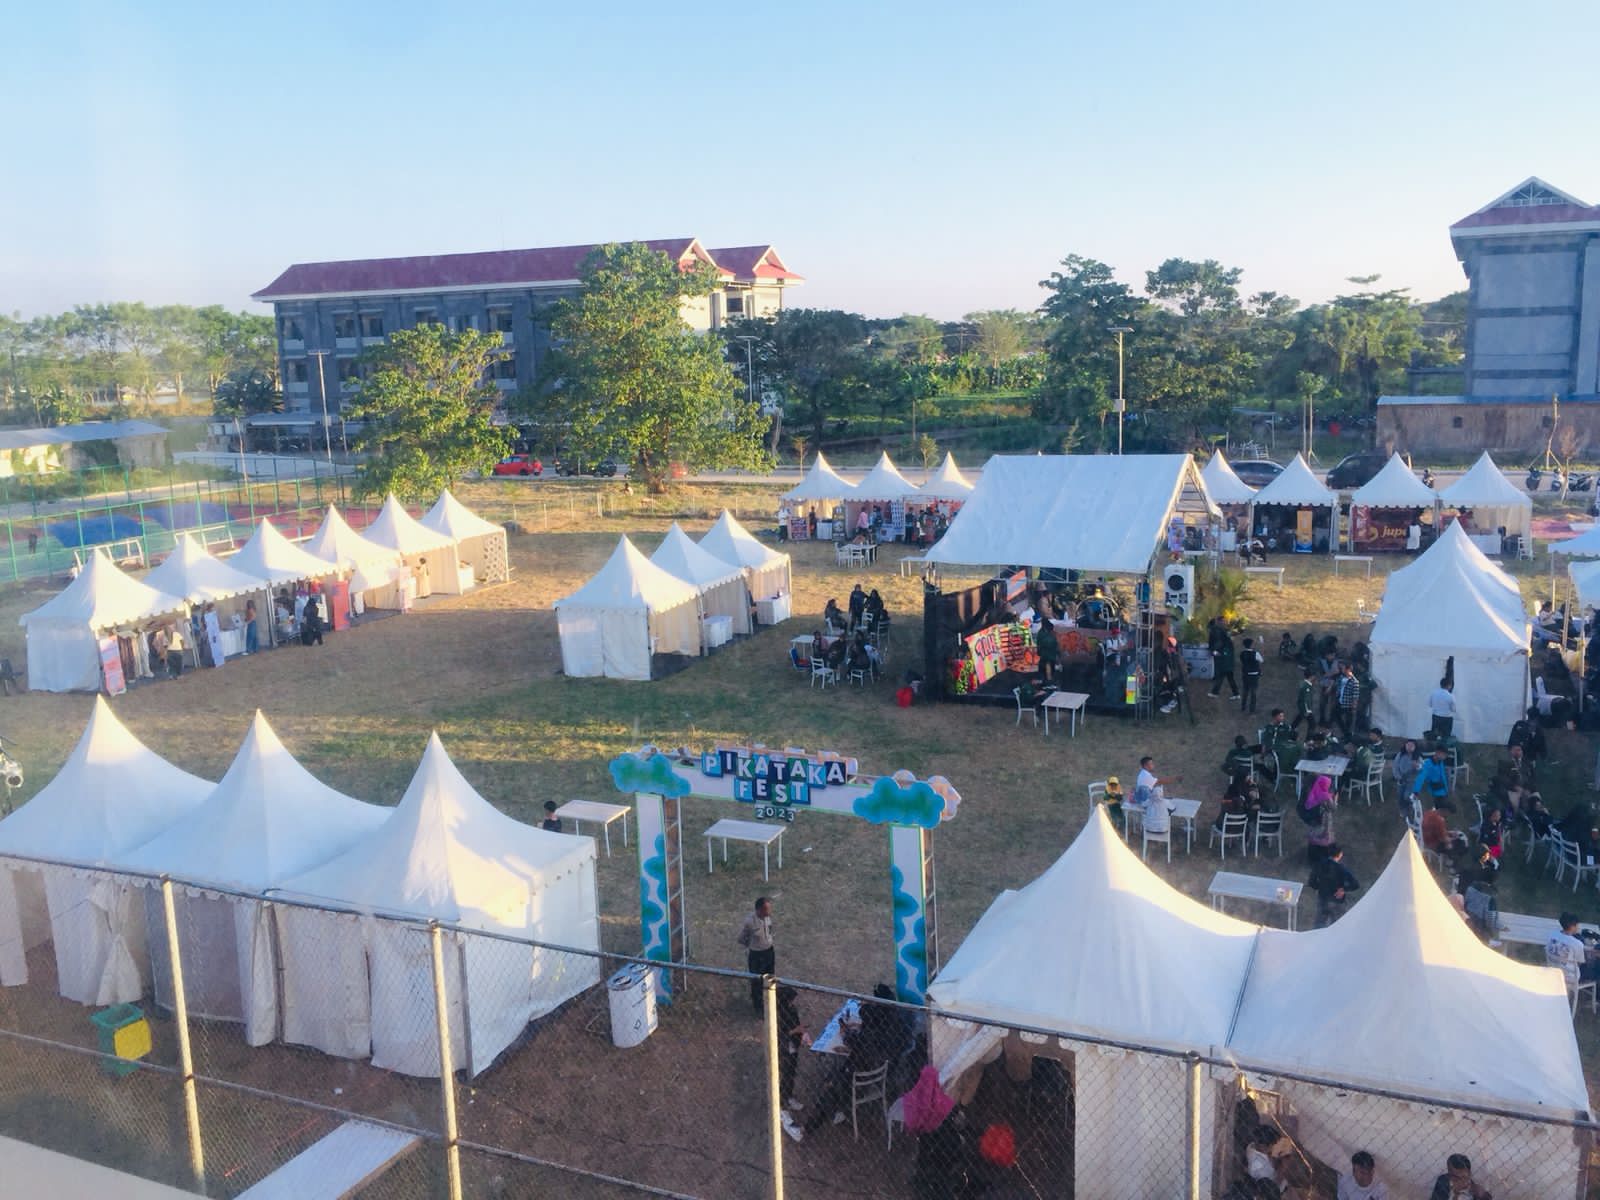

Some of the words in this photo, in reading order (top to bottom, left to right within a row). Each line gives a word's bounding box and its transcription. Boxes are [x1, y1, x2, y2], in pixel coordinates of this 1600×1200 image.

[705, 753, 845, 785] PIKATAKA
[739, 779, 804, 803] FEST
[756, 807, 795, 822] 2023
